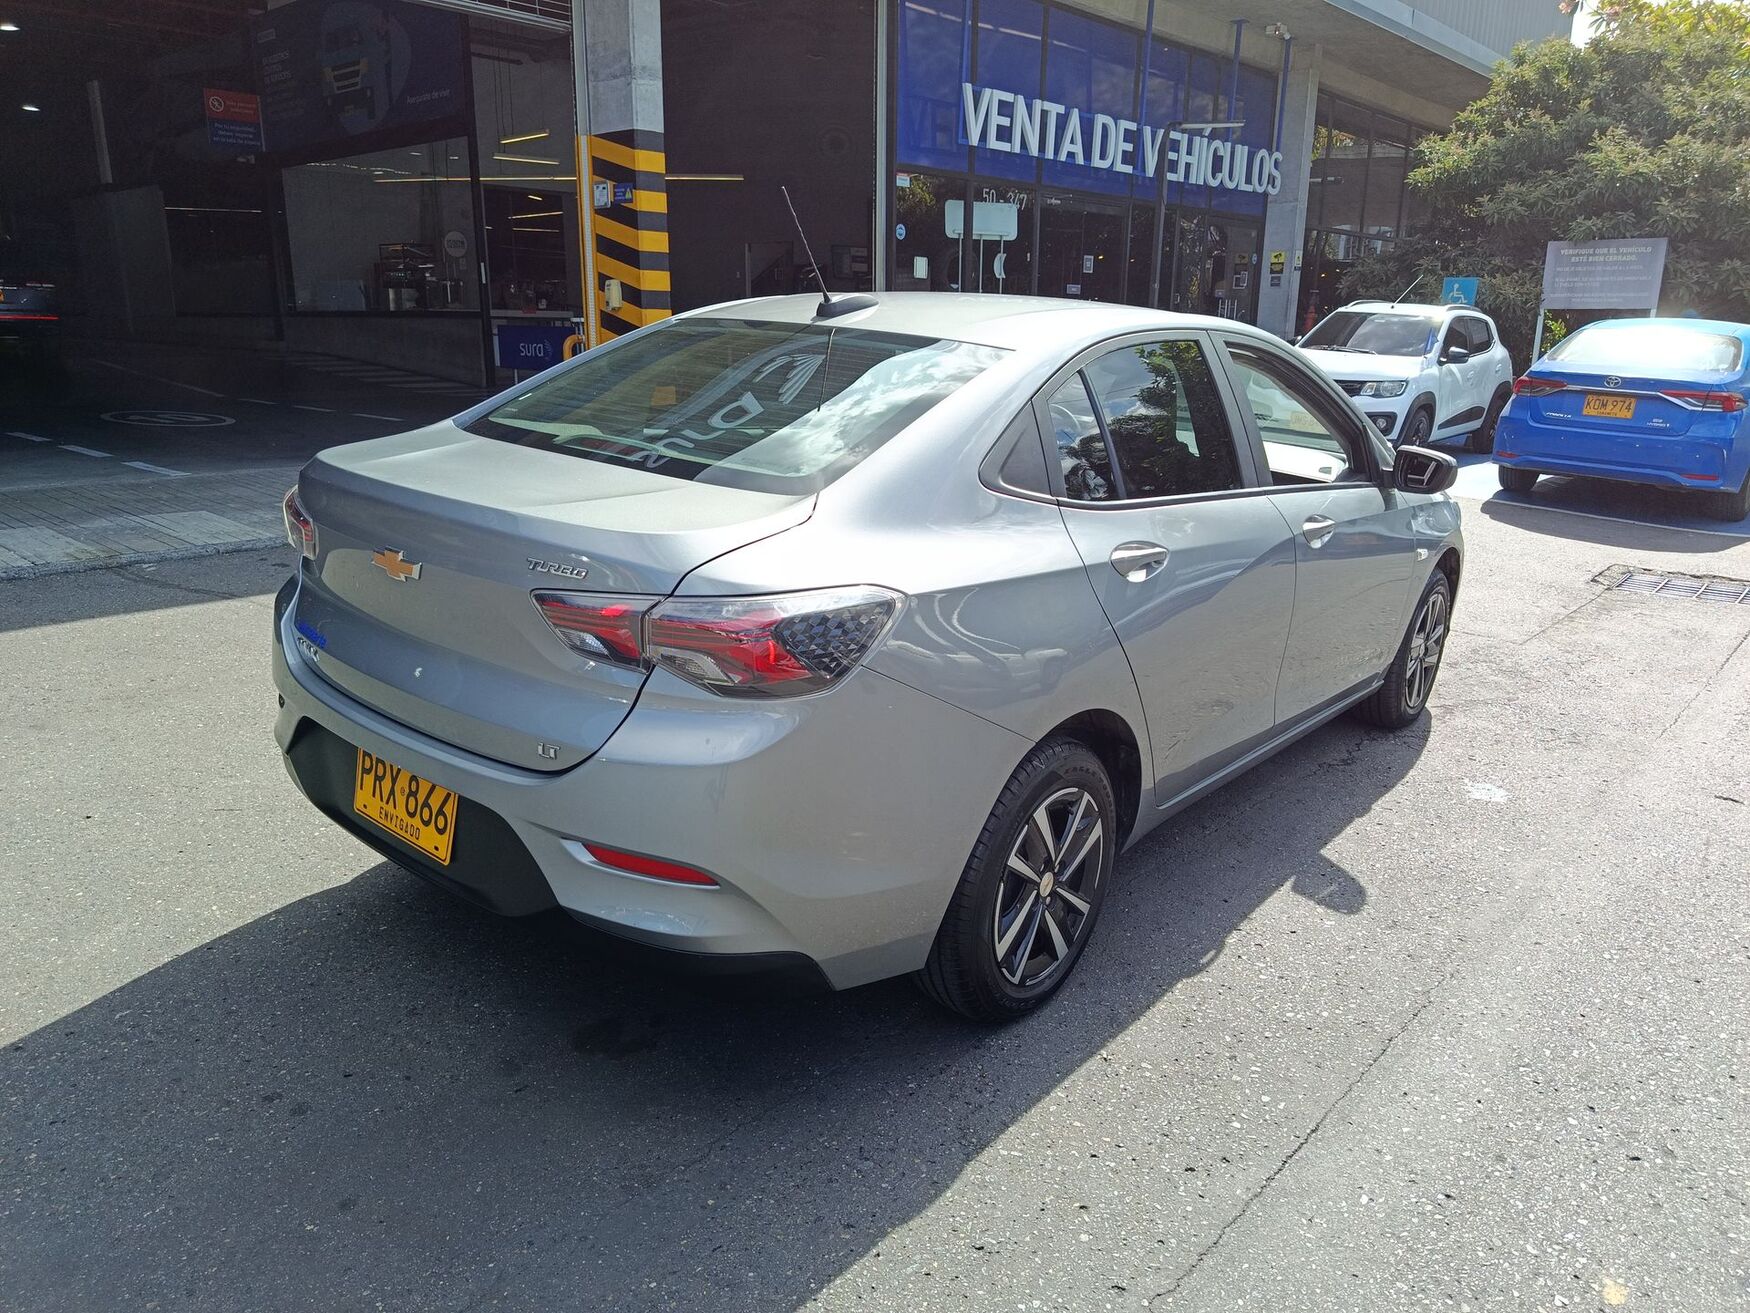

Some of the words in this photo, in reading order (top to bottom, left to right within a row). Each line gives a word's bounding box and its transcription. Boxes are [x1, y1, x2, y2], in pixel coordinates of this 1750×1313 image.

[962, 82, 1084, 165] VENTA
[1091, 113, 1137, 174] DE
[1143, 126, 1283, 196] VEHÍCULOS
[1595, 247, 1609, 255] QUE
[519, 342, 545, 357] sura
[1585, 397, 1609, 411] KOM
[1610, 399, 1633, 413] 974
[526, 557, 589, 579] TURBO
[537, 742, 561, 760] LT
[360, 750, 402, 810] PRX
[405, 775, 449, 836] 866
[379, 806, 421, 841] ENVIGADO
